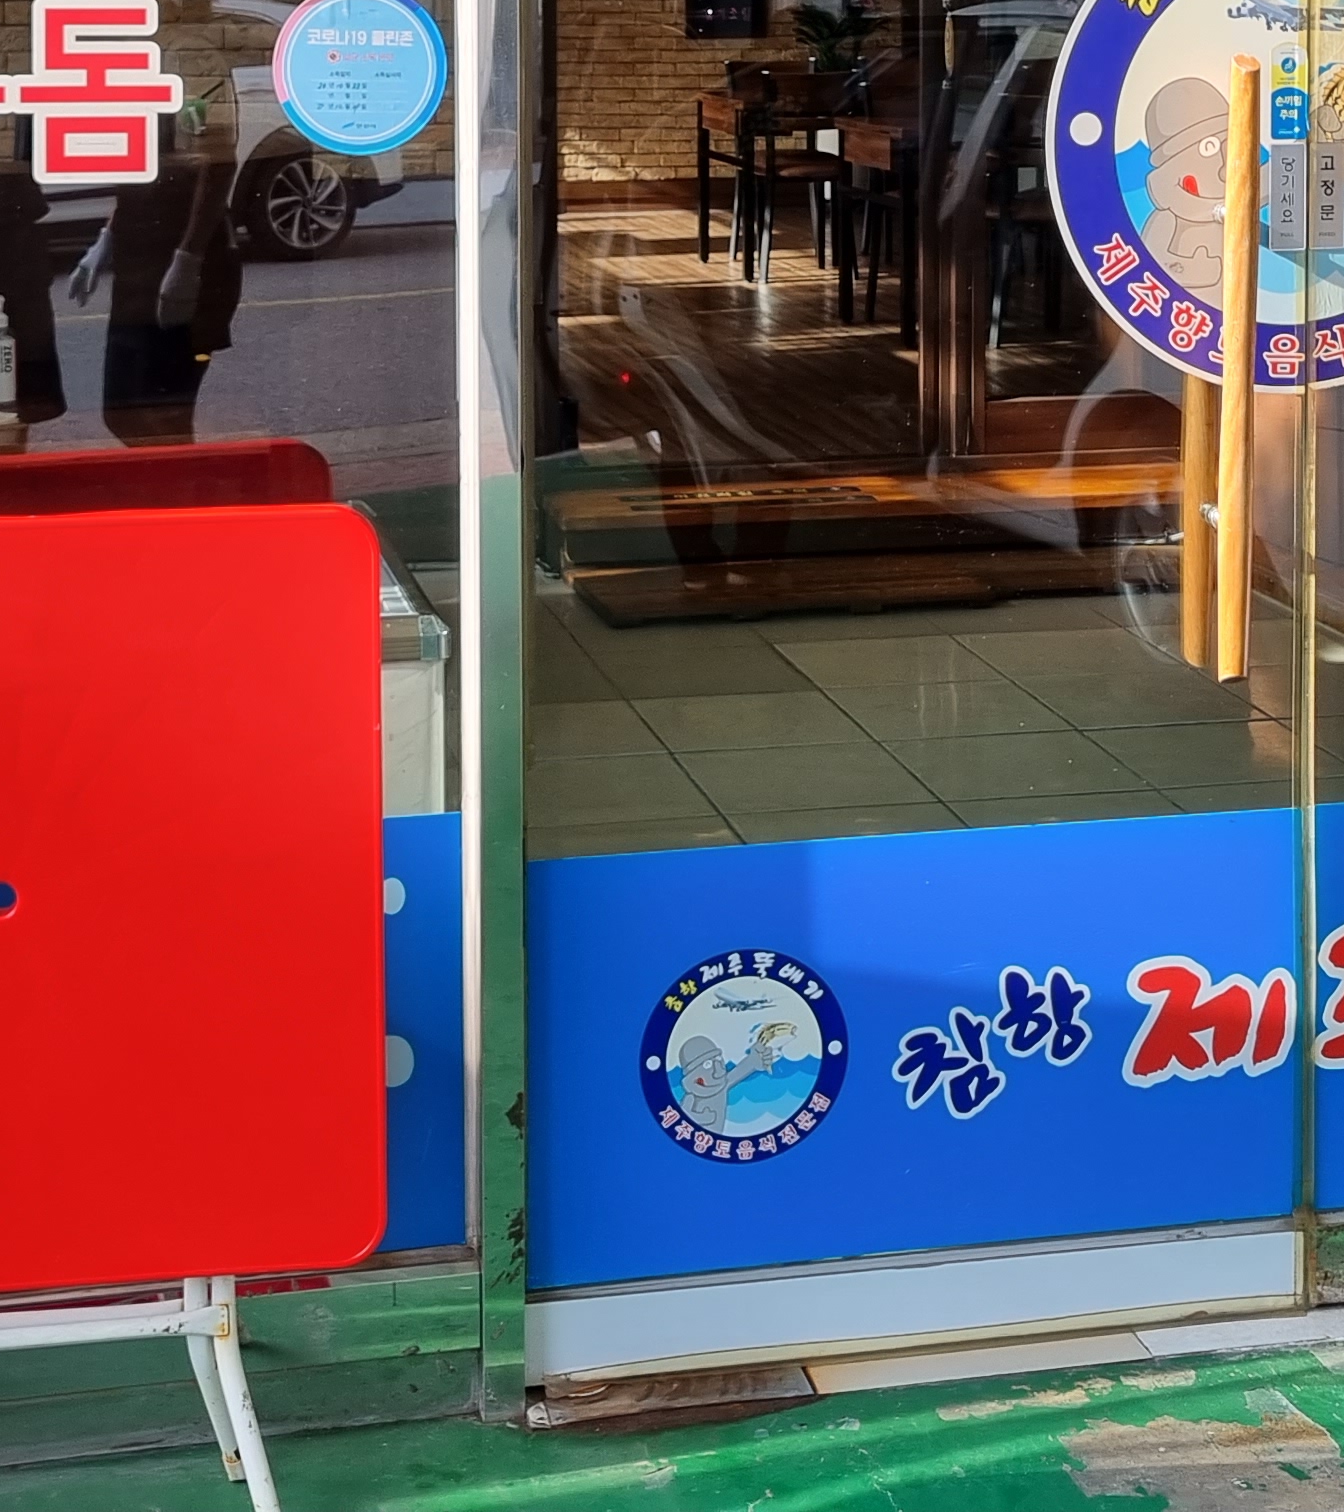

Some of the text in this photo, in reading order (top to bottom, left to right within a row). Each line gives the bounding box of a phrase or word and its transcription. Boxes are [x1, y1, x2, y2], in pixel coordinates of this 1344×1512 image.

[306, 30, 366, 46] 코로나19
[1275, 95, 1302, 106] 손끼임
[1279, 109, 1298, 120] 주의
[1280, 157, 1296, 223] 당기세요
[1320, 155, 1335, 221] 고정문
[892, 967, 1094, 1120] 참향
